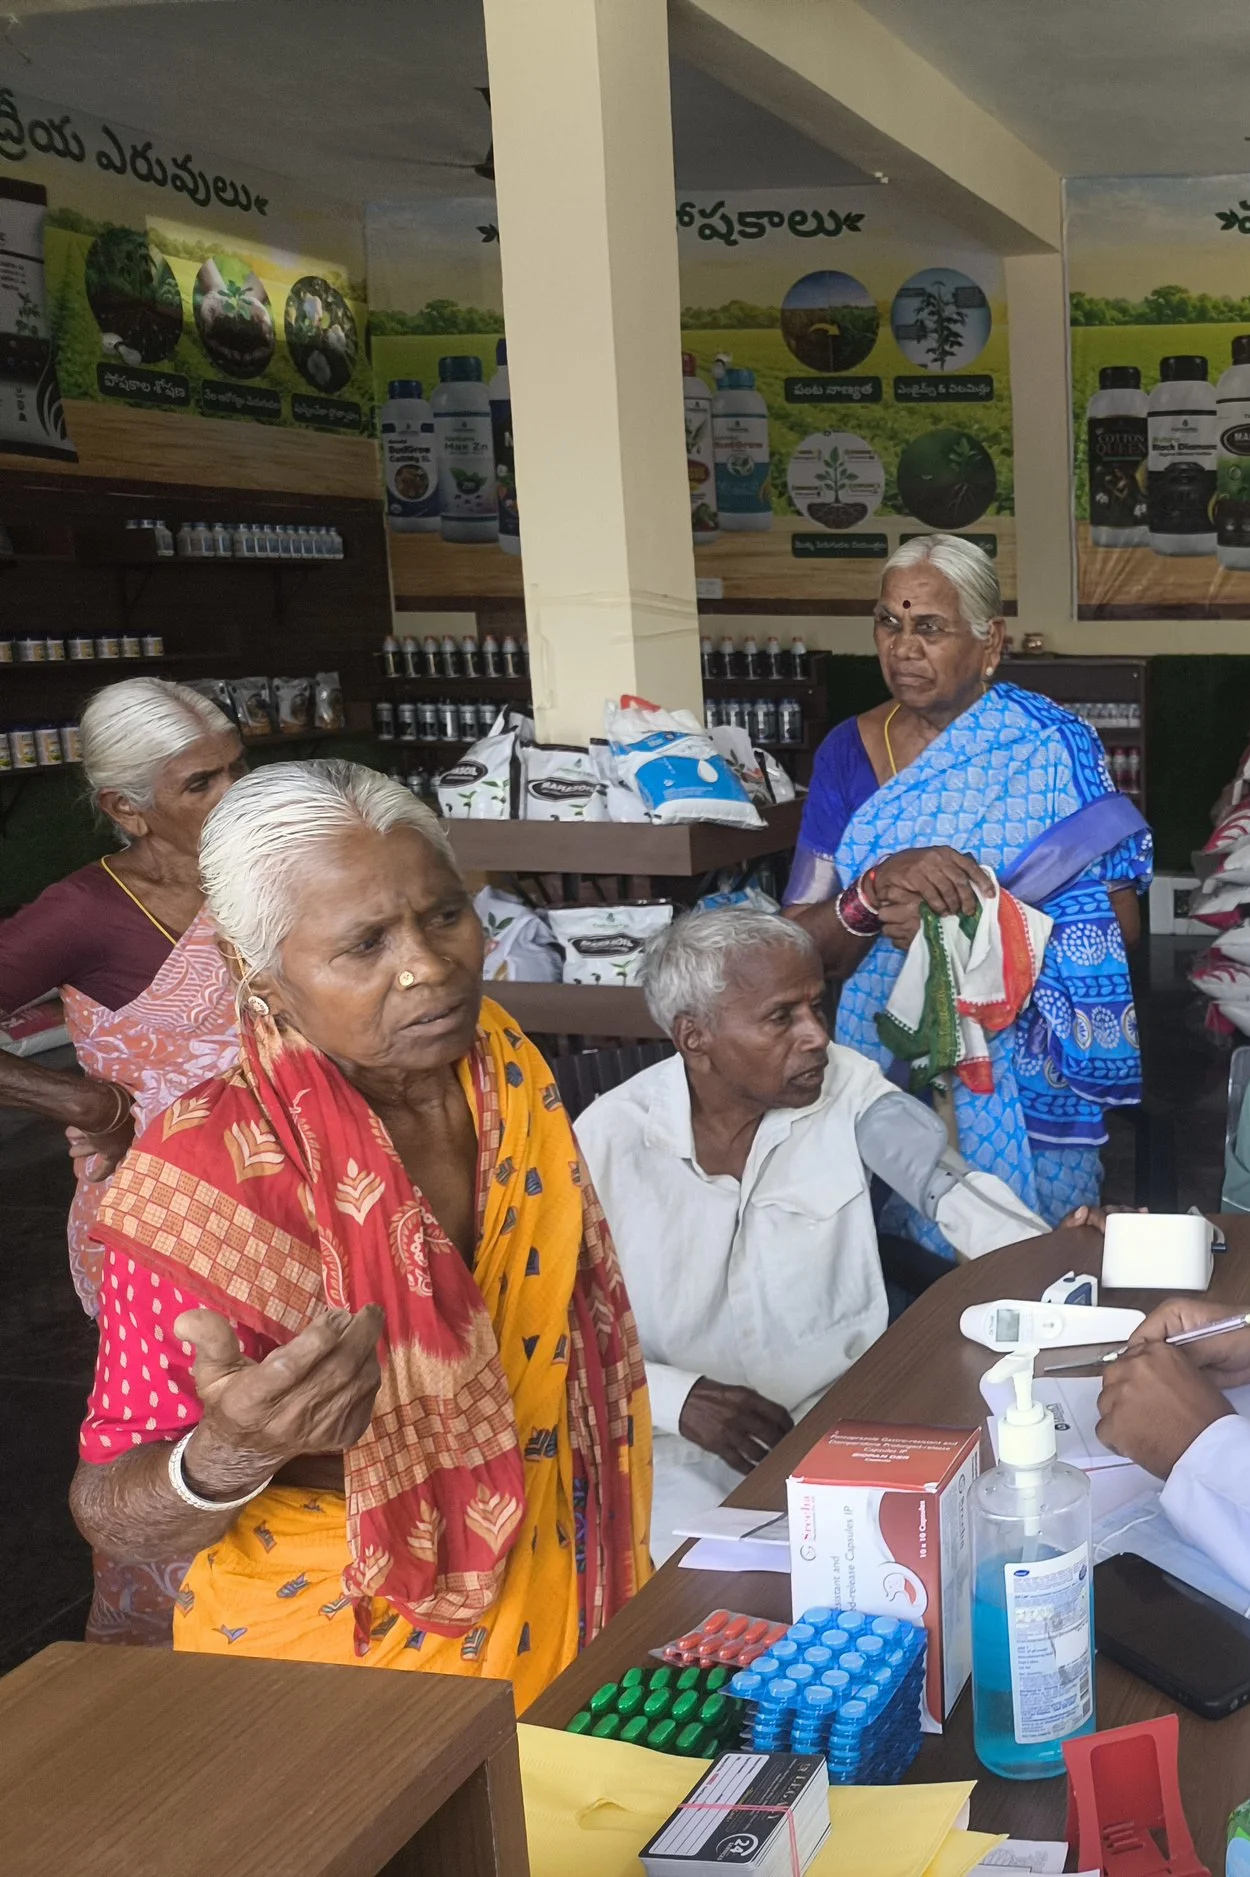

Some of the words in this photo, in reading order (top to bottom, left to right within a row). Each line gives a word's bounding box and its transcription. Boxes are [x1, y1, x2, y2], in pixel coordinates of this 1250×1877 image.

[96, 123, 253, 212] ఎరువులు
[863, 1446, 898, 1454] Capsules
[842, 1505, 853, 1516] IP
[918, 1500, 927, 1531] Capsules
[844, 1519, 856, 1561] Capsules
[918, 1532, 927, 1541] 10
[919, 1549, 927, 1558] 10
[831, 1555, 842, 1573] and
[729, 1838, 750, 1854] 24
